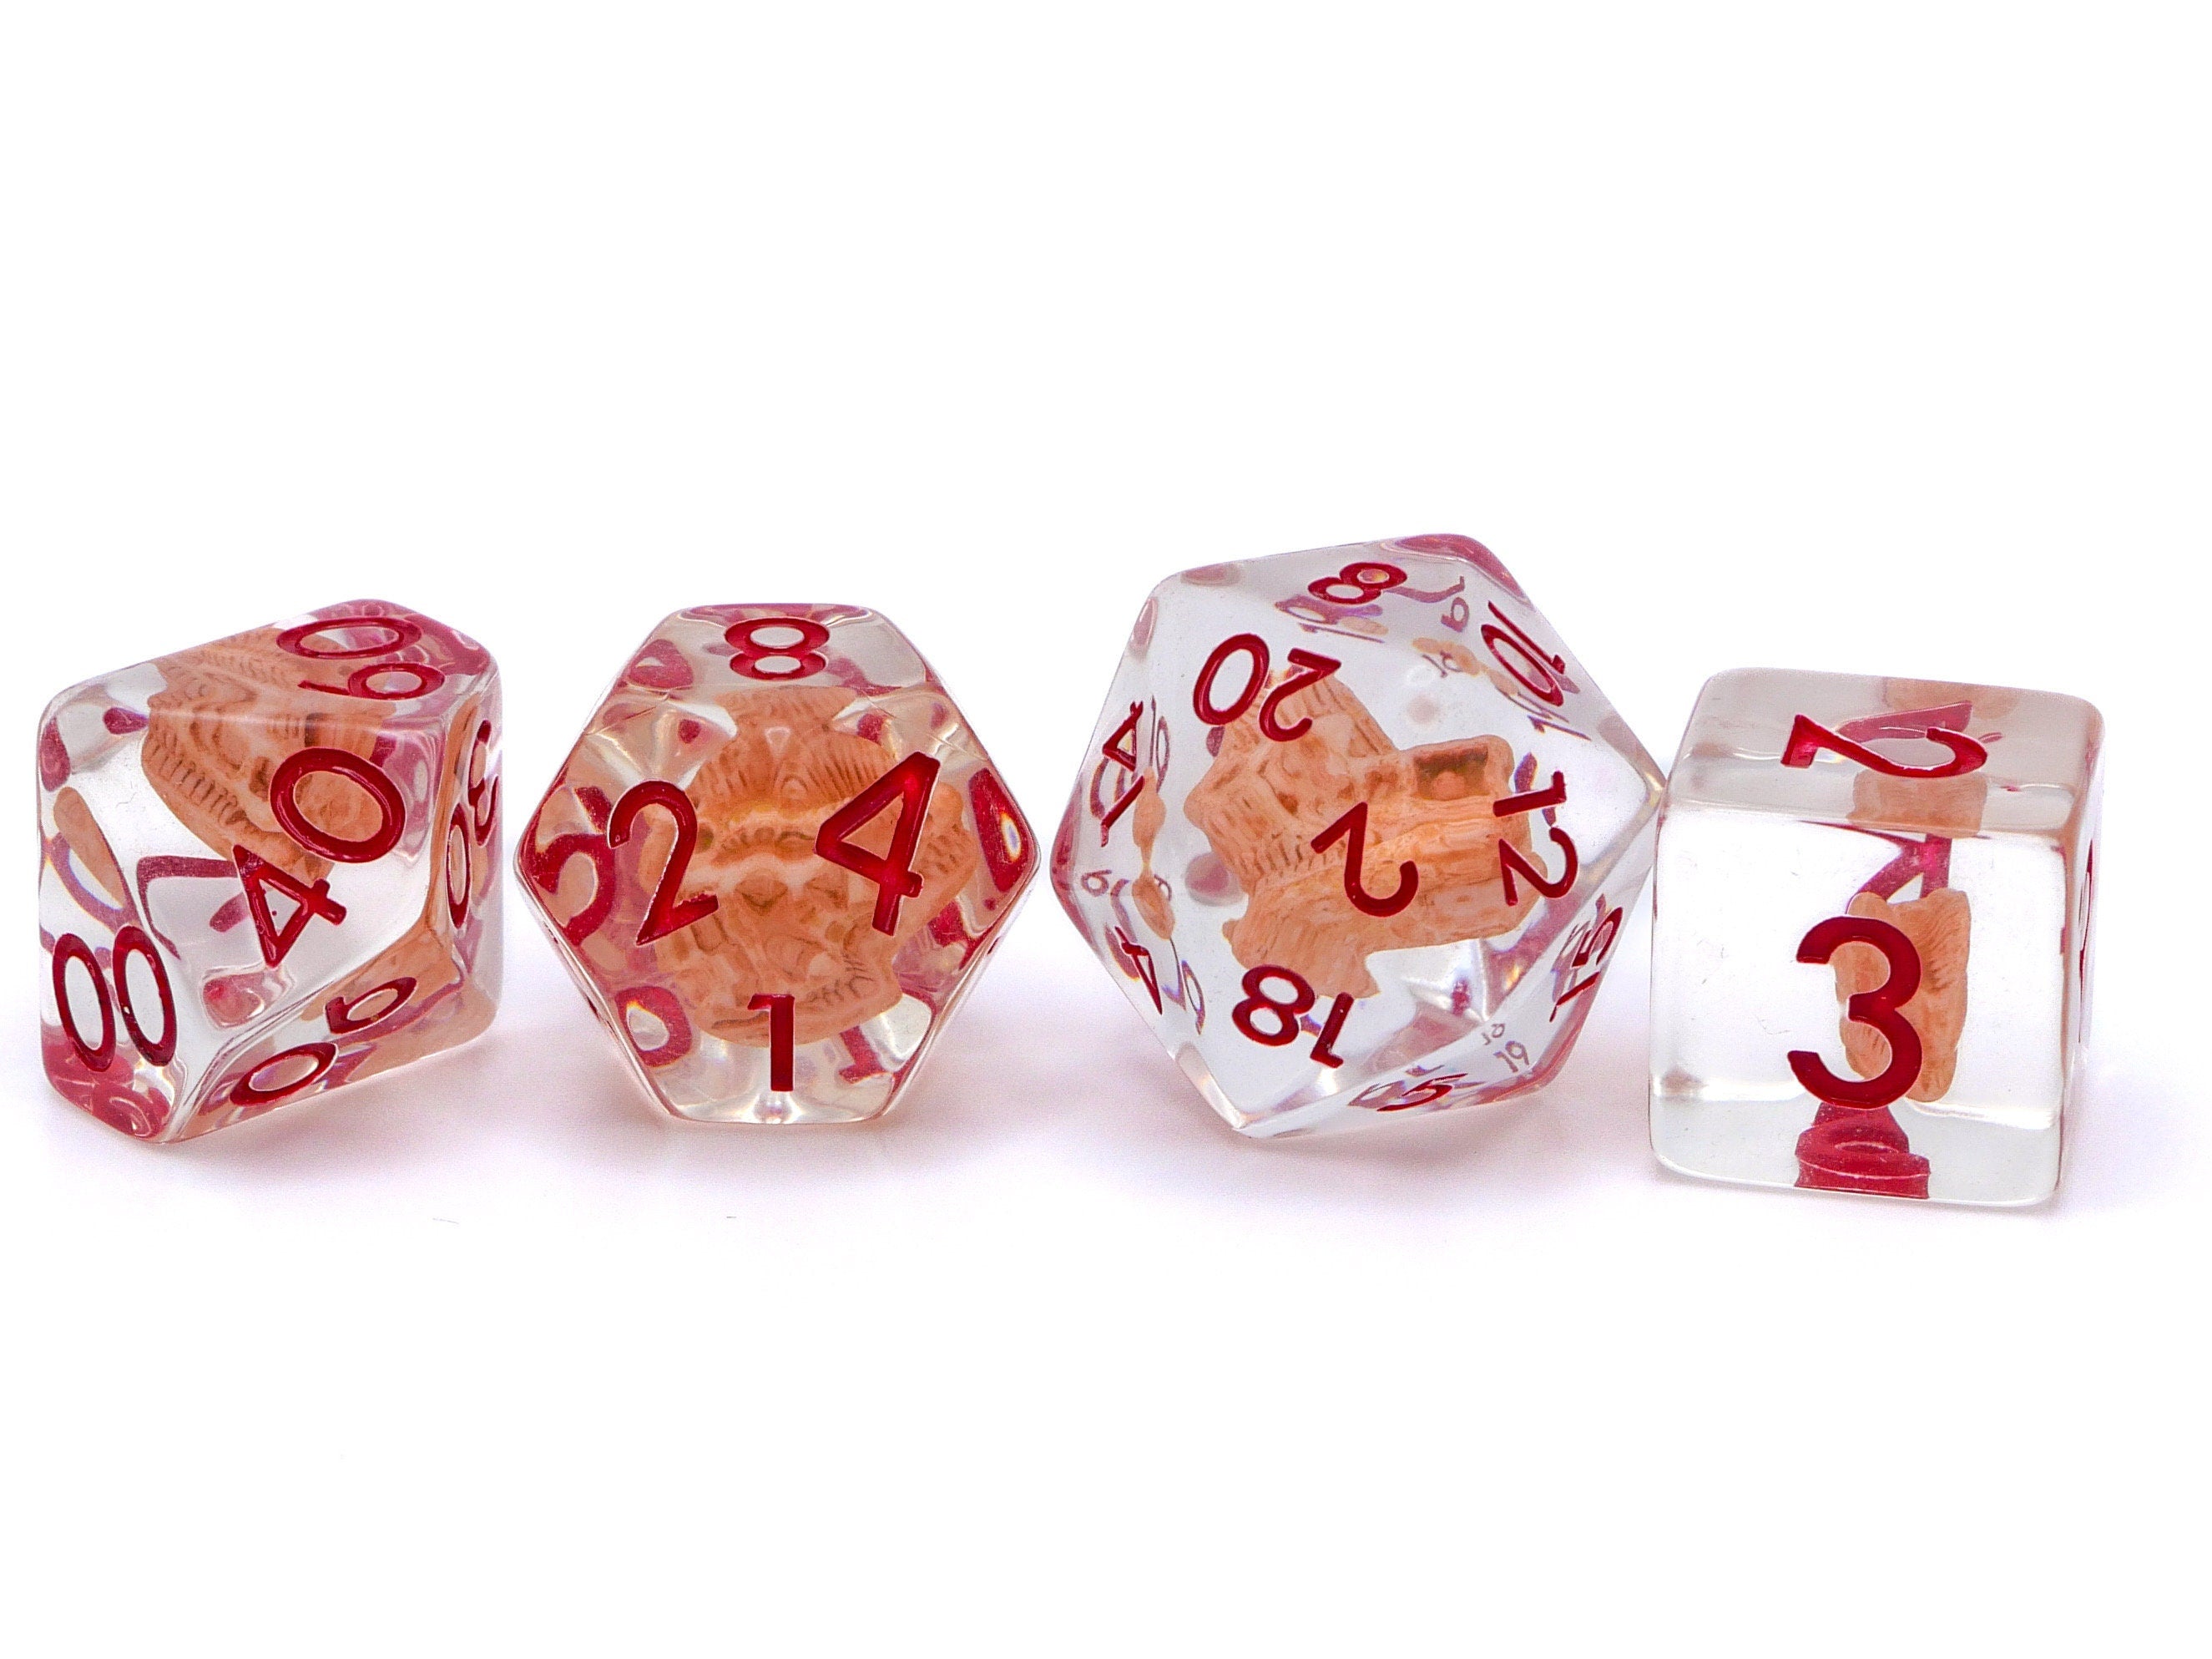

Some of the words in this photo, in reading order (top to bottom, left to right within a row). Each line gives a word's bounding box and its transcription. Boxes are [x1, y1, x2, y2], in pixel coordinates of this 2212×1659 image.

[1305, 561, 1408, 605] 8
[724, 617, 830, 680] 8
[1193, 633, 1341, 742] 20
[1481, 599, 1567, 707] 10
[1100, 701, 1144, 847] 14
[1780, 714, 1987, 778] 2
[231, 747, 407, 968] 40
[608, 780, 720, 946] 2
[815, 751, 941, 936] 4
[1311, 802, 1419, 918] 2
[1492, 771, 1579, 907] 12
[52, 924, 177, 1074] 00
[1114, 925, 1163, 1015] 4
[1231, 964, 1354, 1067] 18
[1549, 907, 1624, 1023] 15
[1786, 915, 1922, 1110] 3
[747, 994, 795, 1092] 1
[1376, 1073, 1467, 1113] 5
